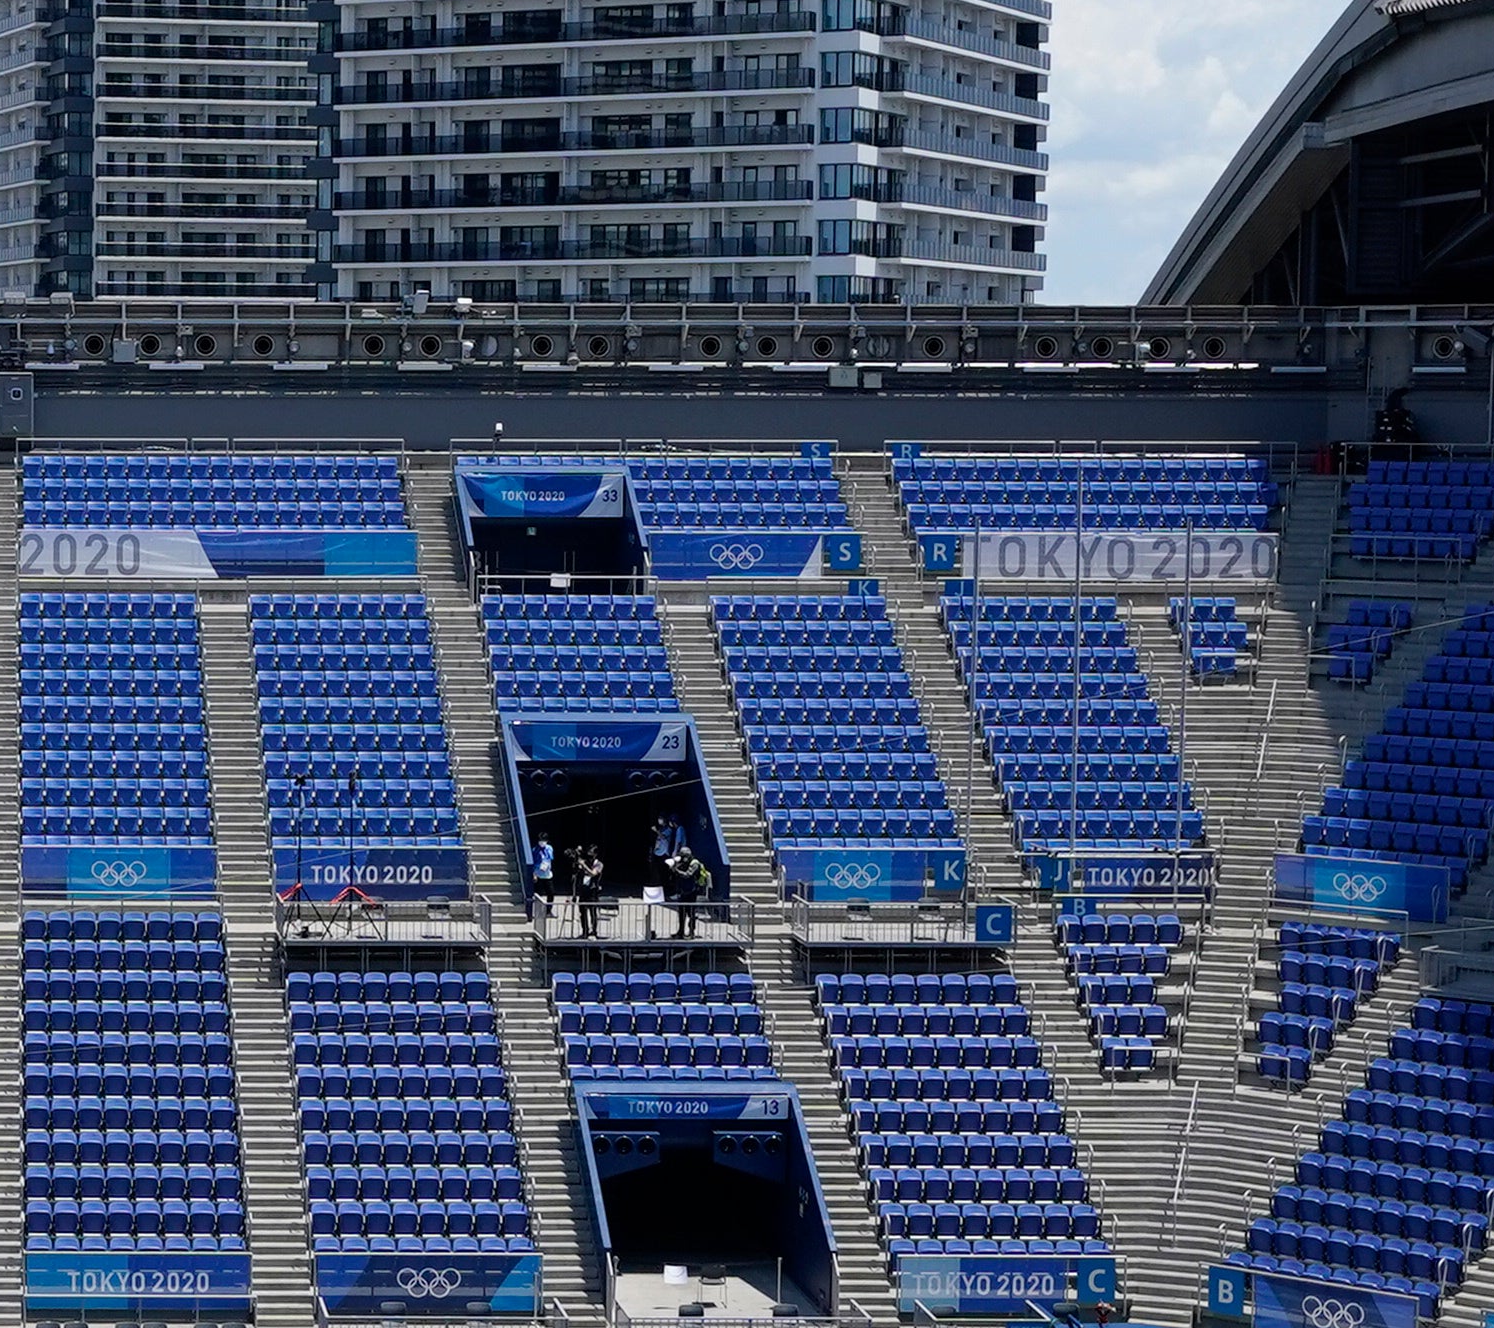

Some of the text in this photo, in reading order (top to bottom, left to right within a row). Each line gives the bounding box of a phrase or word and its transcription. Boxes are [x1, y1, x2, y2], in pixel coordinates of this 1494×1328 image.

[501, 491, 565, 502] TOKYO 2020
[603, 490, 618, 502] 33
[23, 533, 140, 576] 2020
[840, 543, 853, 560] S
[934, 543, 947, 562] R
[972, 534, 1275, 578] TOKYO 2020
[550, 737, 621, 749] TOKYO 2020
[662, 736, 679, 749] 23
[311, 863, 433, 885] TOKYO 2020
[944, 860, 960, 880] K
[1088, 866, 1209, 885] TOKYO 2020
[1075, 898, 1085, 914] B
[986, 913, 1002, 935] C
[629, 1101, 708, 1114] TOKYO 2020
[762, 1100, 779, 1115] 13
[69, 1269, 210, 1294] TOKYO 2020
[913, 1274, 1055, 1298] TOKYO 2020
[1088, 1270, 1106, 1293] C
[1219, 1279, 1233, 1303] B
